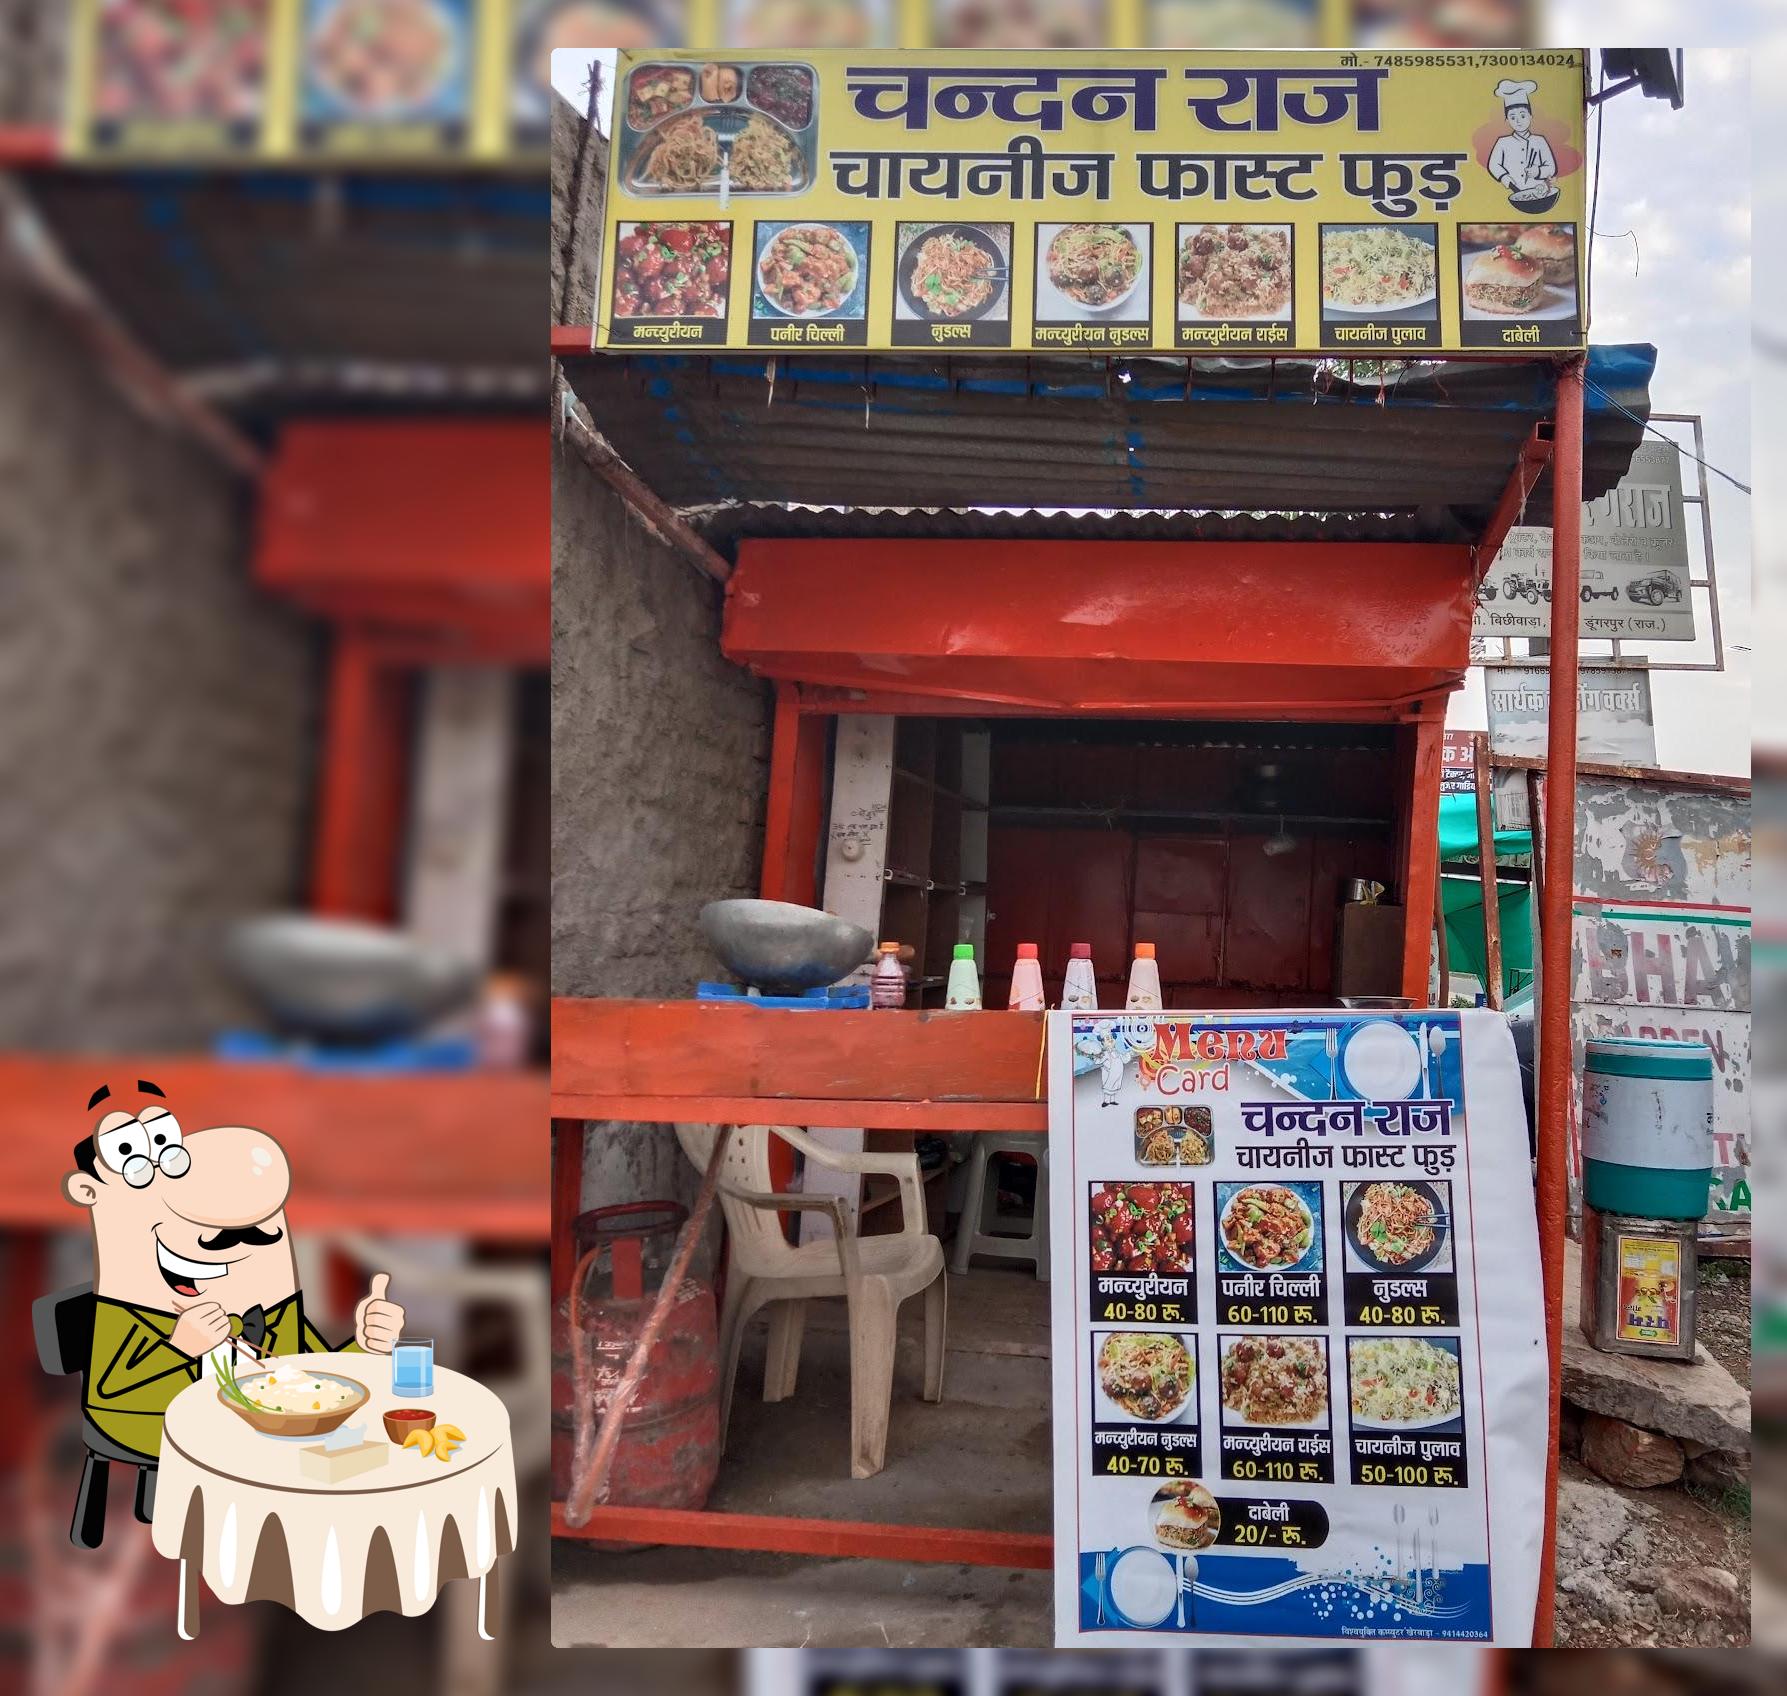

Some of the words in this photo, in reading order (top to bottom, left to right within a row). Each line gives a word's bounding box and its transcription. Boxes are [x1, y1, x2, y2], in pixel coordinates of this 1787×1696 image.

[1374, 54, 1575, 68] 7485985531,7300134024
[846, 67, 1167, 131] चन्दन
[1185, 67, 1389, 132] राज
[829, 135, 1115, 200] चायनीज
[1136, 153, 1324, 200] फास्ट
[1339, 153, 1468, 218] फुड़
[770, 323, 802, 341] पनीर
[806, 323, 845, 342] चिल्ली
[931, 323, 971, 343] नुडल्स
[1109, 326, 1149, 345] नुडल्स
[1256, 325, 1288, 343] राईस
[1334, 323, 1388, 342] चायनीज
[1392, 326, 1426, 343] पुलाव
[1502, 325, 1540, 343] दाबेली
[1152, 1022, 1288, 1062] Menu
[1156, 1063, 1230, 1095] Card
[1241, 1102, 1366, 1136] चन्दन
[1372, 1100, 1452, 1136] राज
[1235, 1137, 1333, 1168] चायनीज
[1341, 1144, 1406, 1168] फास्ट
[1412, 1144, 1457, 1175] फुड़
[1098, 1272, 1188, 1300] मन्च्युरीयन
[1221, 1274, 1265, 1297] पनीर
[1269, 1274, 1321, 1298] चिल्ली
[1372, 1279, 1427, 1303] नुडल्स
[1104, 1303, 1157, 1321] 40-80
[1228, 1305, 1289, 1324] 60-110
[1359, 1305, 1415, 1324] 40-80
[1161, 1433, 1197, 1450] नुडल्स
[1298, 1434, 1331, 1456] राईस
[1355, 1435, 1416, 1456] चायनीज
[1420, 1441, 1461, 1461] पुलाव
[1107, 1456, 1160, 1475] 40-70
[1232, 1460, 1294, 1480] 60-110
[1361, 1465, 1428, 1485] 50-100
[1247, 1501, 1290, 1521] दाबेली
[1234, 1524, 1277, 1545] 20/-
[1442, 1630, 1488, 1638] 9414420364
